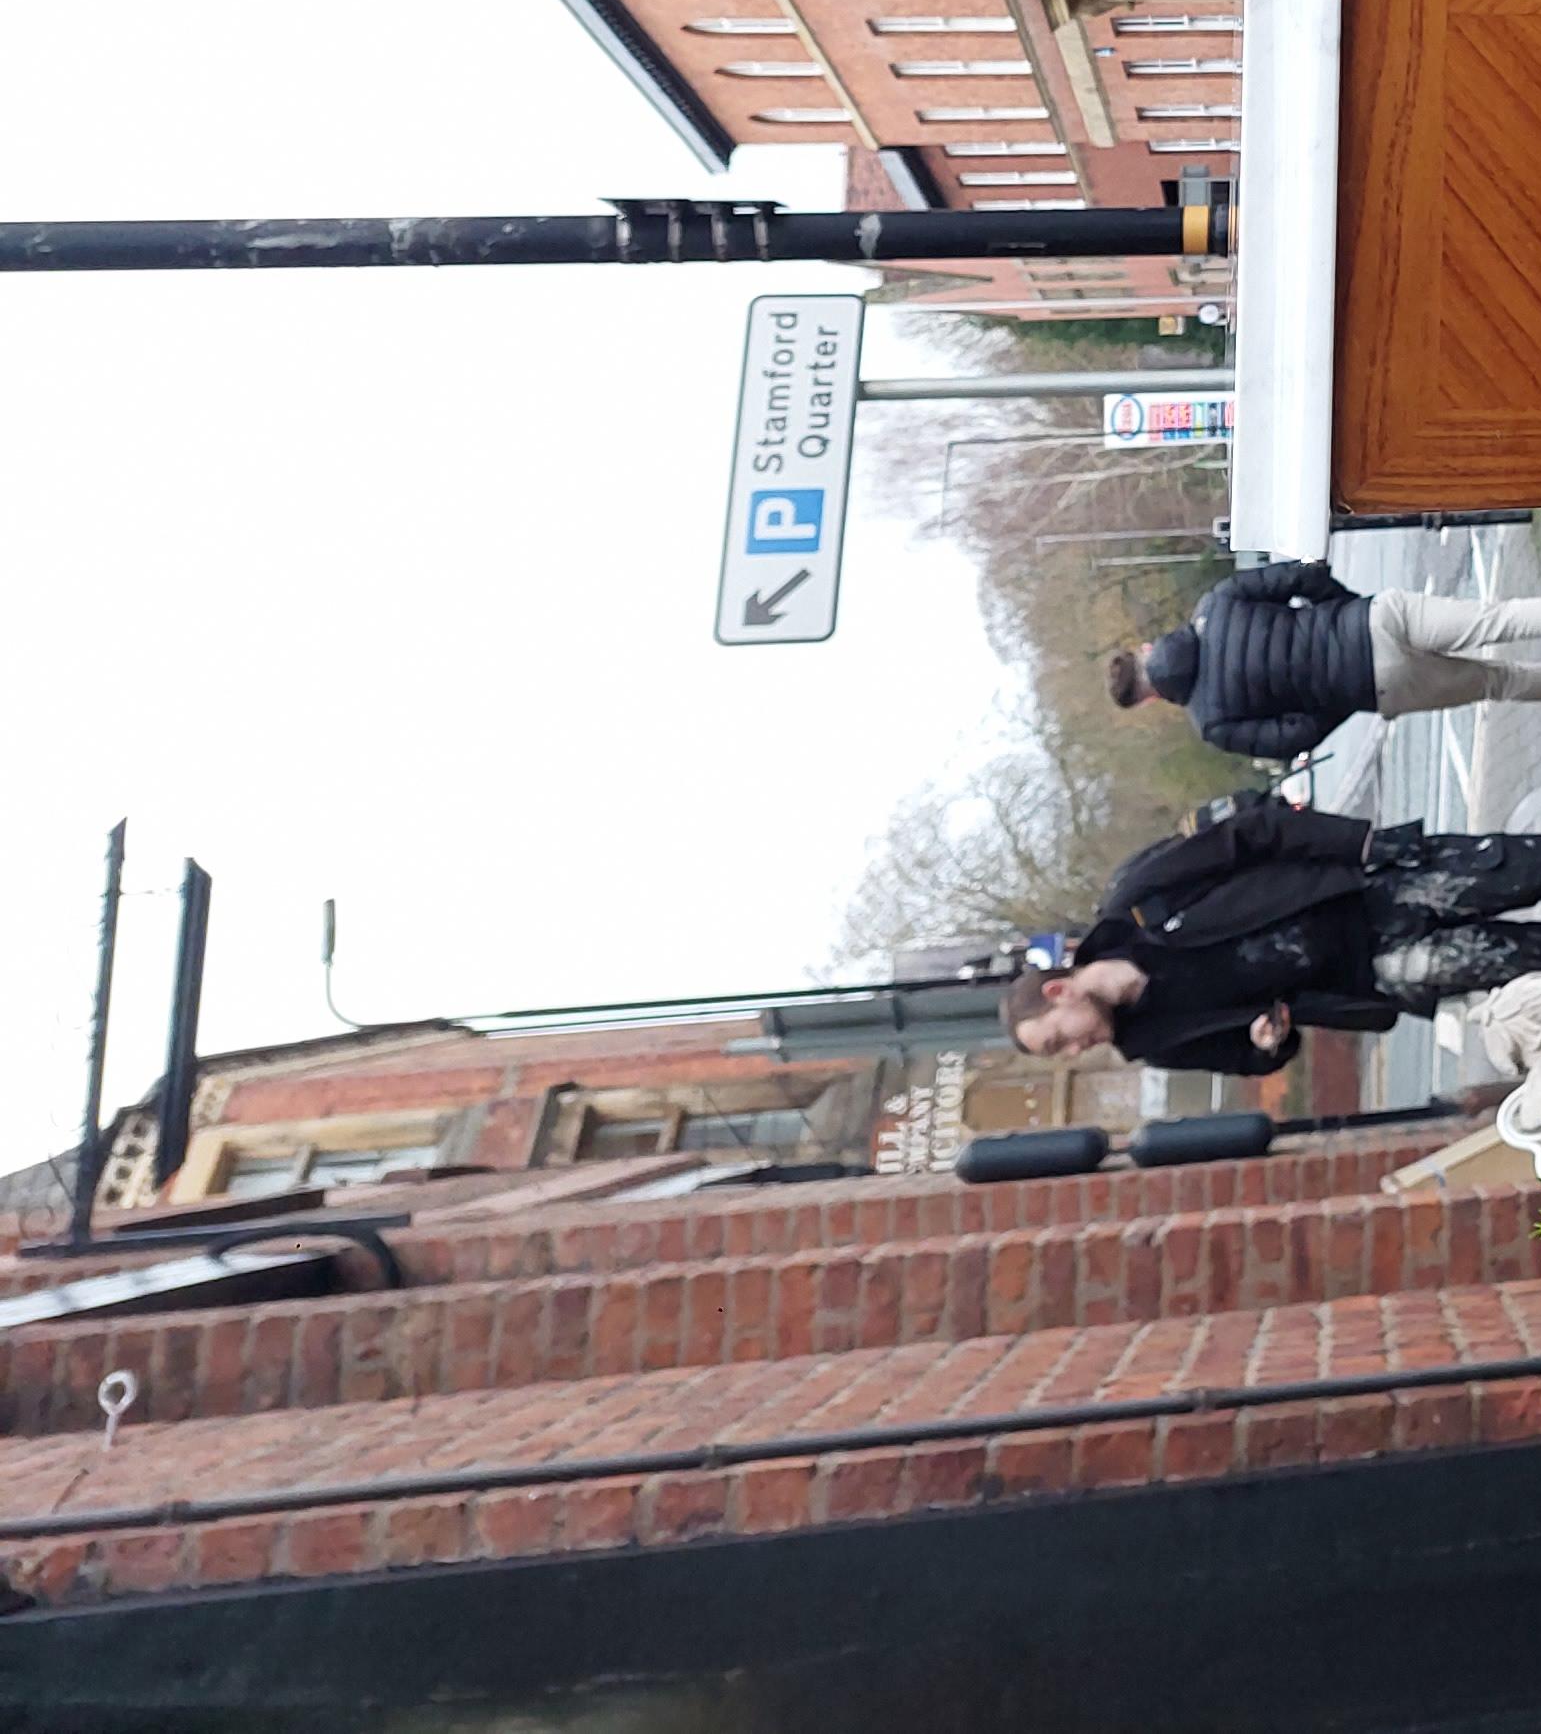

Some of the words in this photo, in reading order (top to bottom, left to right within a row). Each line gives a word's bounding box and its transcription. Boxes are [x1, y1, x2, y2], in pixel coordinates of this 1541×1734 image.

[752, 312, 799, 474] Stamford
[797, 326, 839, 458] Quarter
[752, 496, 817, 540] P
[875, 1121, 906, 1174] ILL
[883, 1094, 908, 1114] &
[930, 1051, 966, 1172] ICITORS
